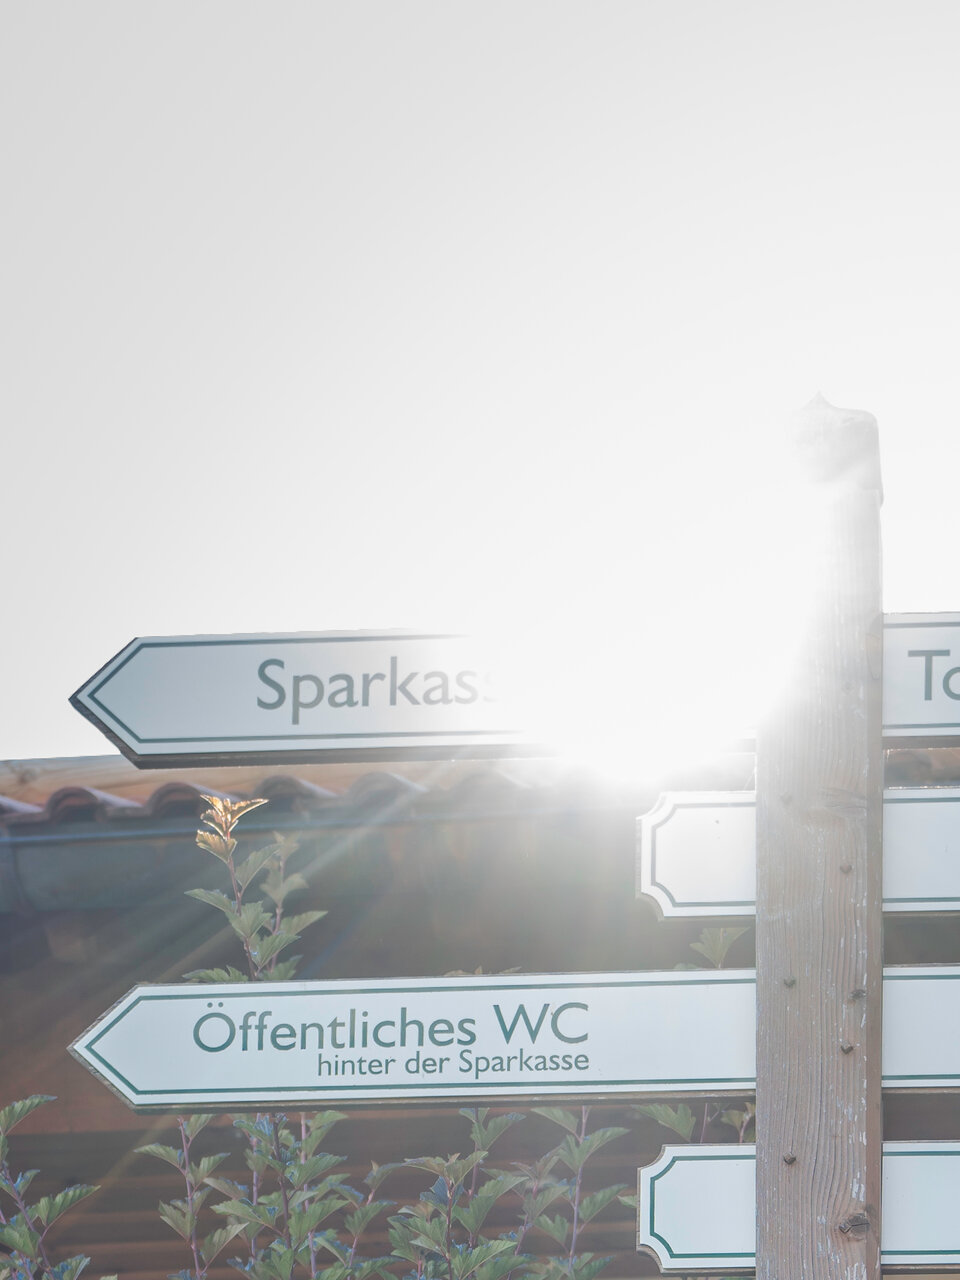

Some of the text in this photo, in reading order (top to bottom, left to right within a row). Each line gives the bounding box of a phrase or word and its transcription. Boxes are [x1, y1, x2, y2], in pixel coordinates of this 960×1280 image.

[193, 1001, 589, 1053] Öffentliches WC
[317, 1049, 590, 1080] hinter der Sparkasse
